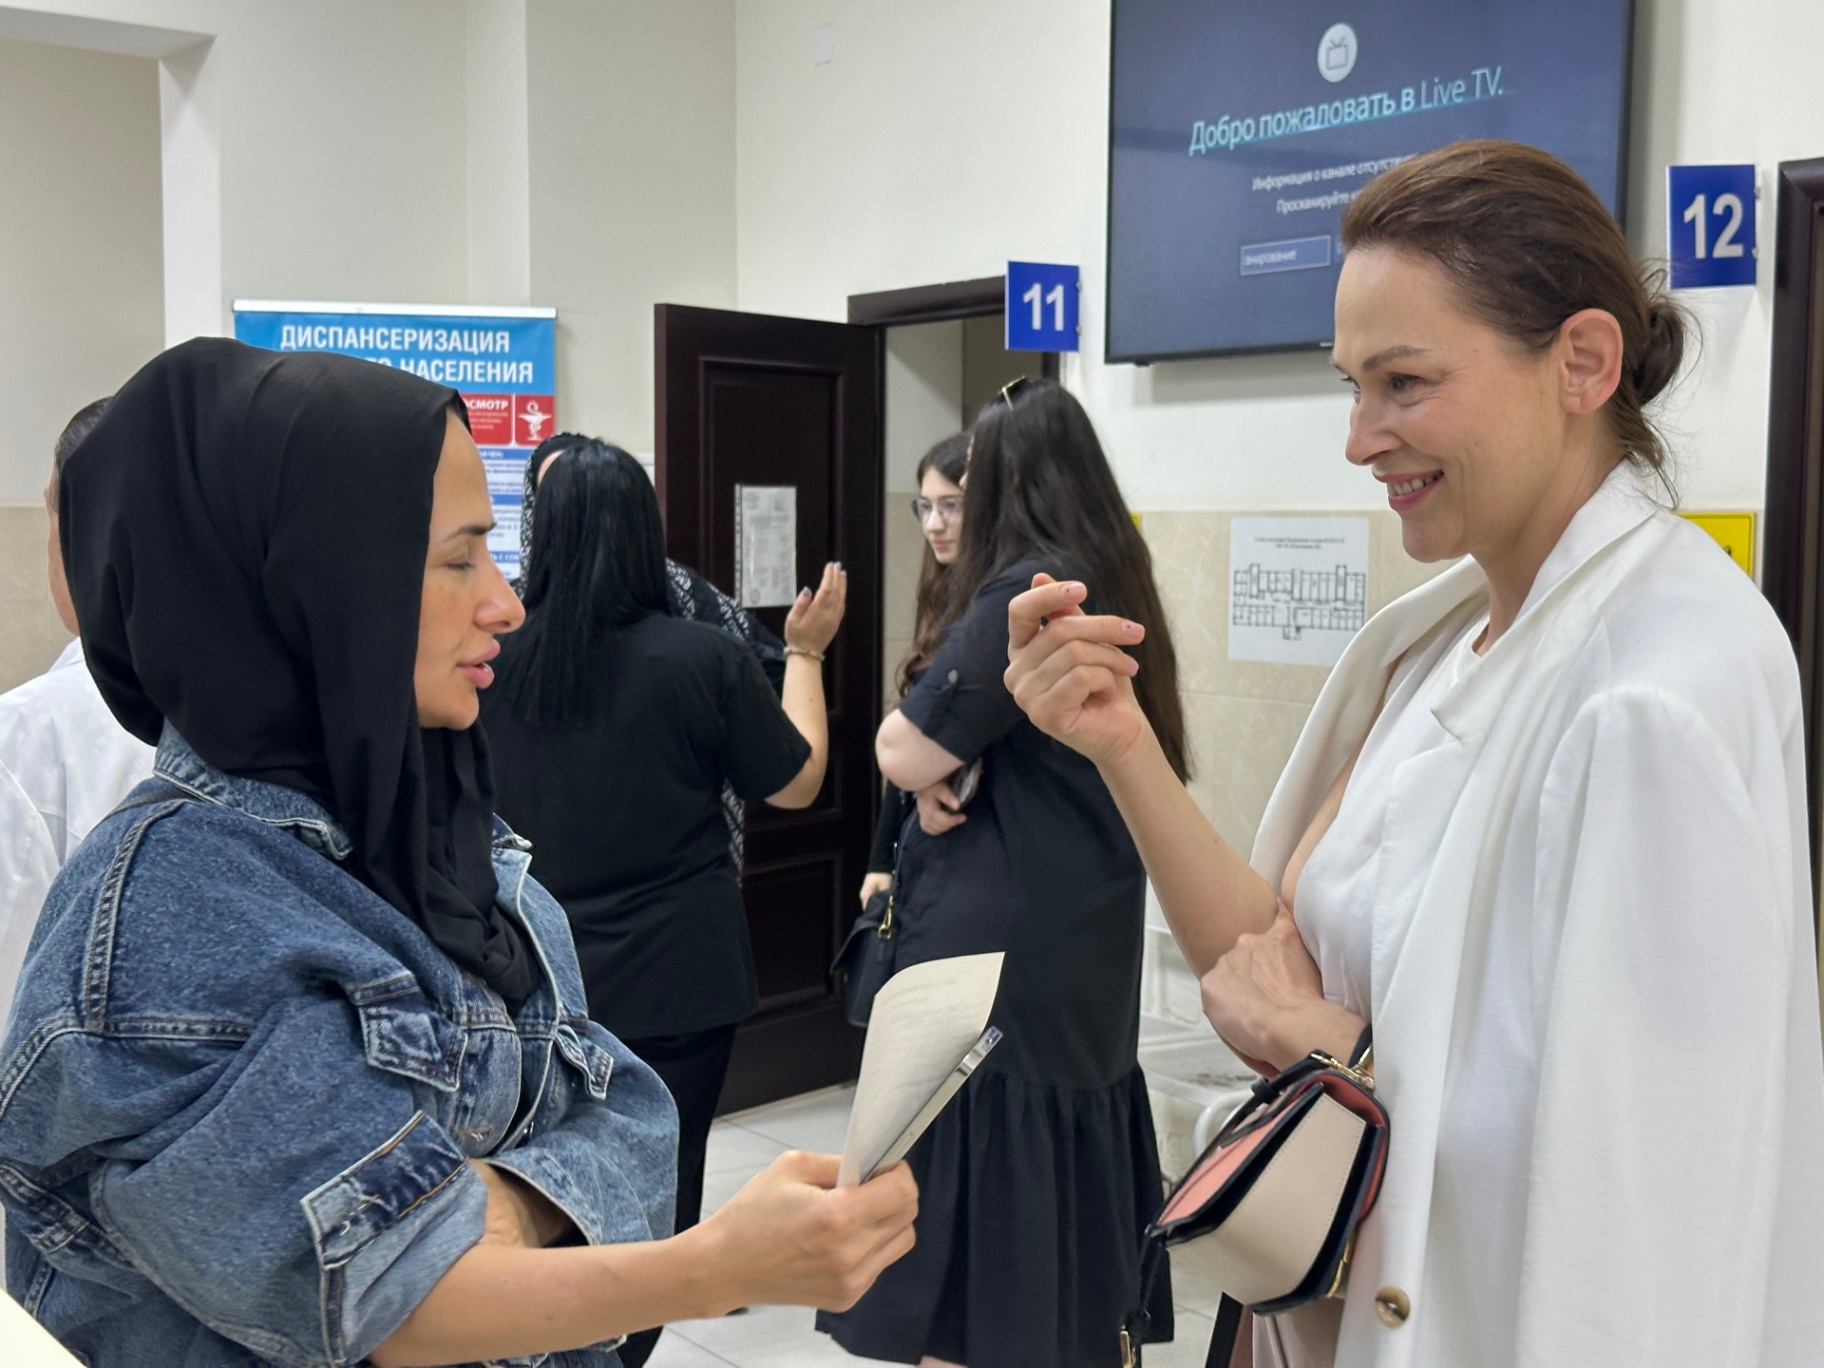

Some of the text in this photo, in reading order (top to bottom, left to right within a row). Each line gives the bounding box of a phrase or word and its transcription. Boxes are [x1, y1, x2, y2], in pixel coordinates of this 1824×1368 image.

[1188, 64, 1504, 156] Добро пожаловать в Live TV.
[1683, 192, 1745, 260] 12
[1023, 282, 1065, 332] 11
[280, 325, 510, 355] ДИСПАНСЕРИЗАЦИЯ
[399, 358, 534, 384] НАСЕЛЕНИЯ
